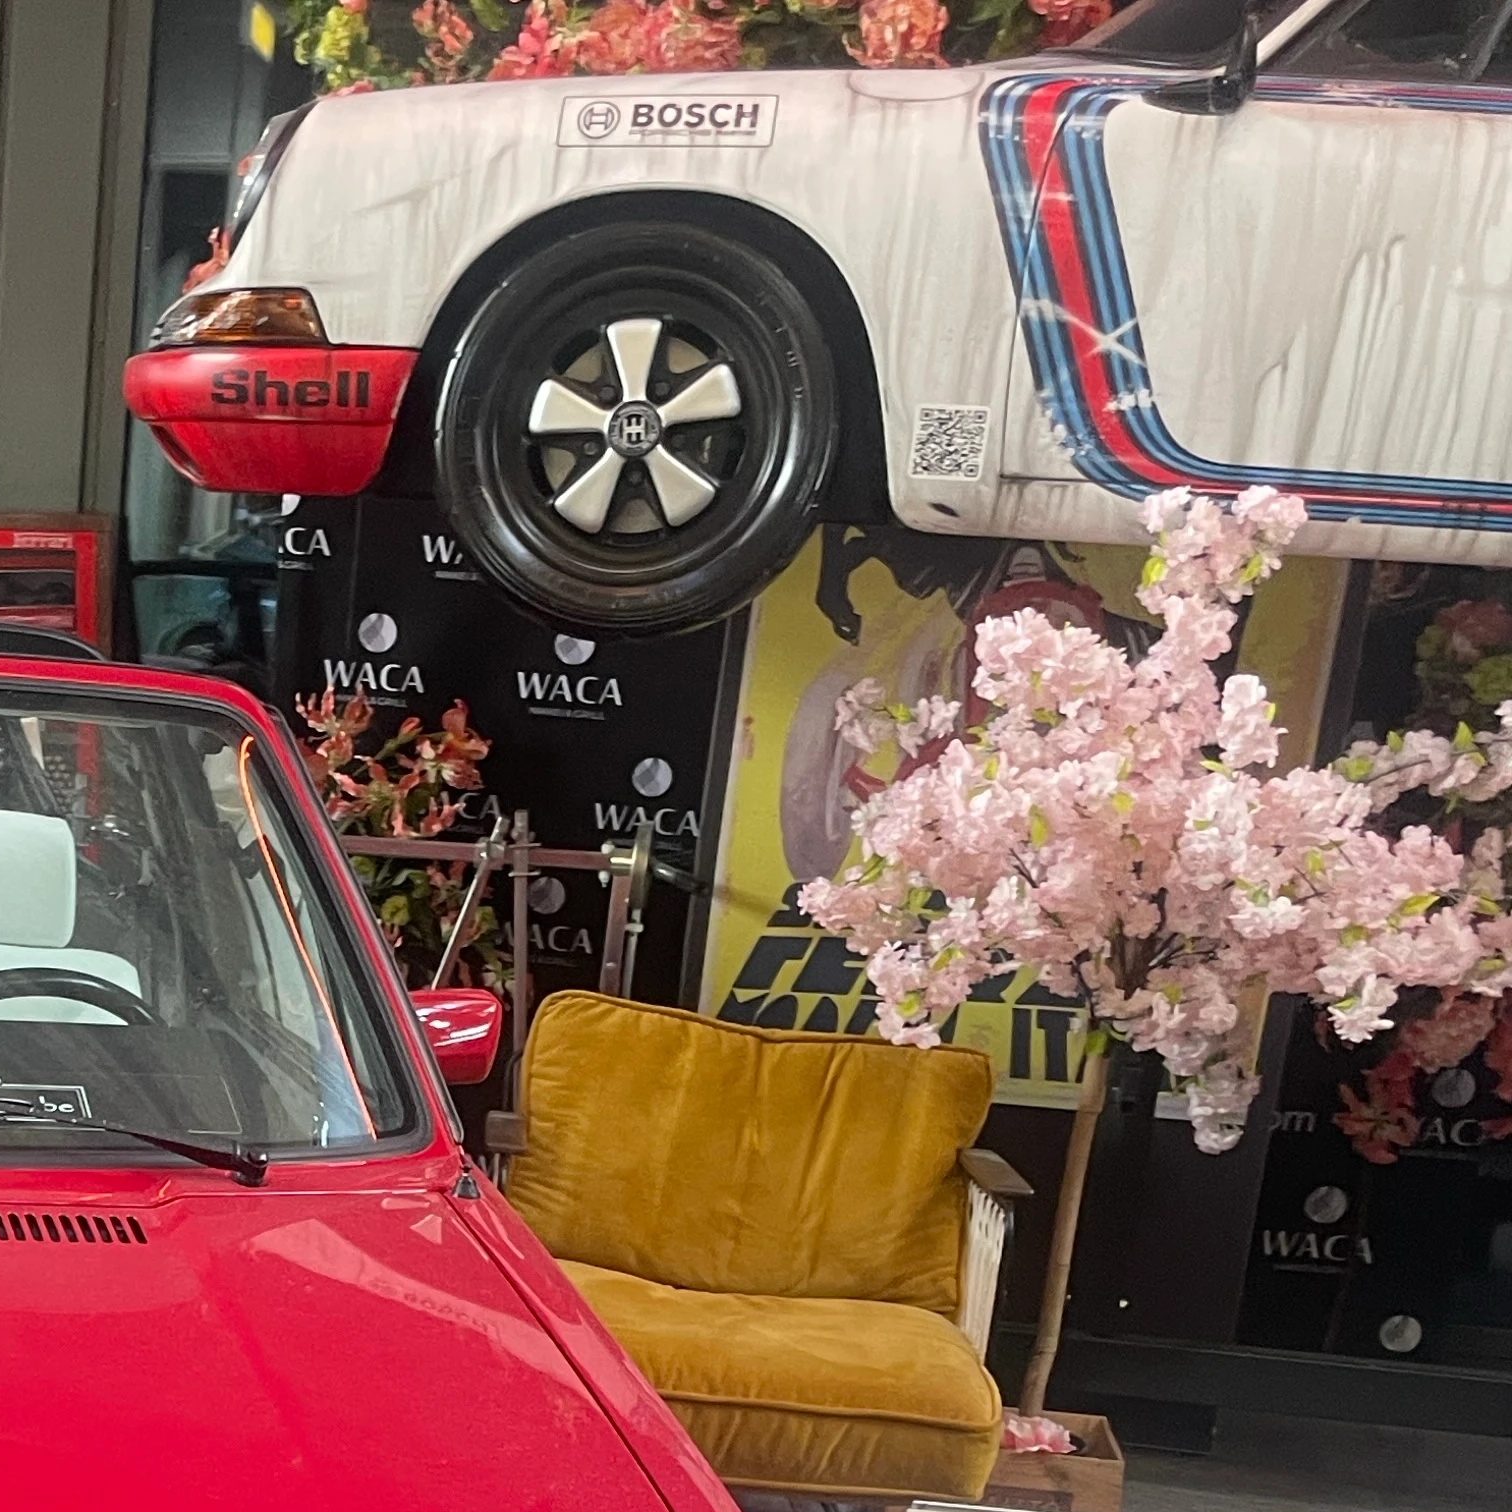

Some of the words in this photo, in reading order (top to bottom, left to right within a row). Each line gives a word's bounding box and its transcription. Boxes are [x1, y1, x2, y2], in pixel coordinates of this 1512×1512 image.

[630, 103, 760, 129] BOSCH
[210, 369, 371, 408] Shell
[278, 527, 332, 557] CA
[323, 658, 426, 694] WACA
[516, 671, 623, 707] WACA
[594, 802, 700, 838] WACA
[1262, 1229, 1376, 1265] WACA
